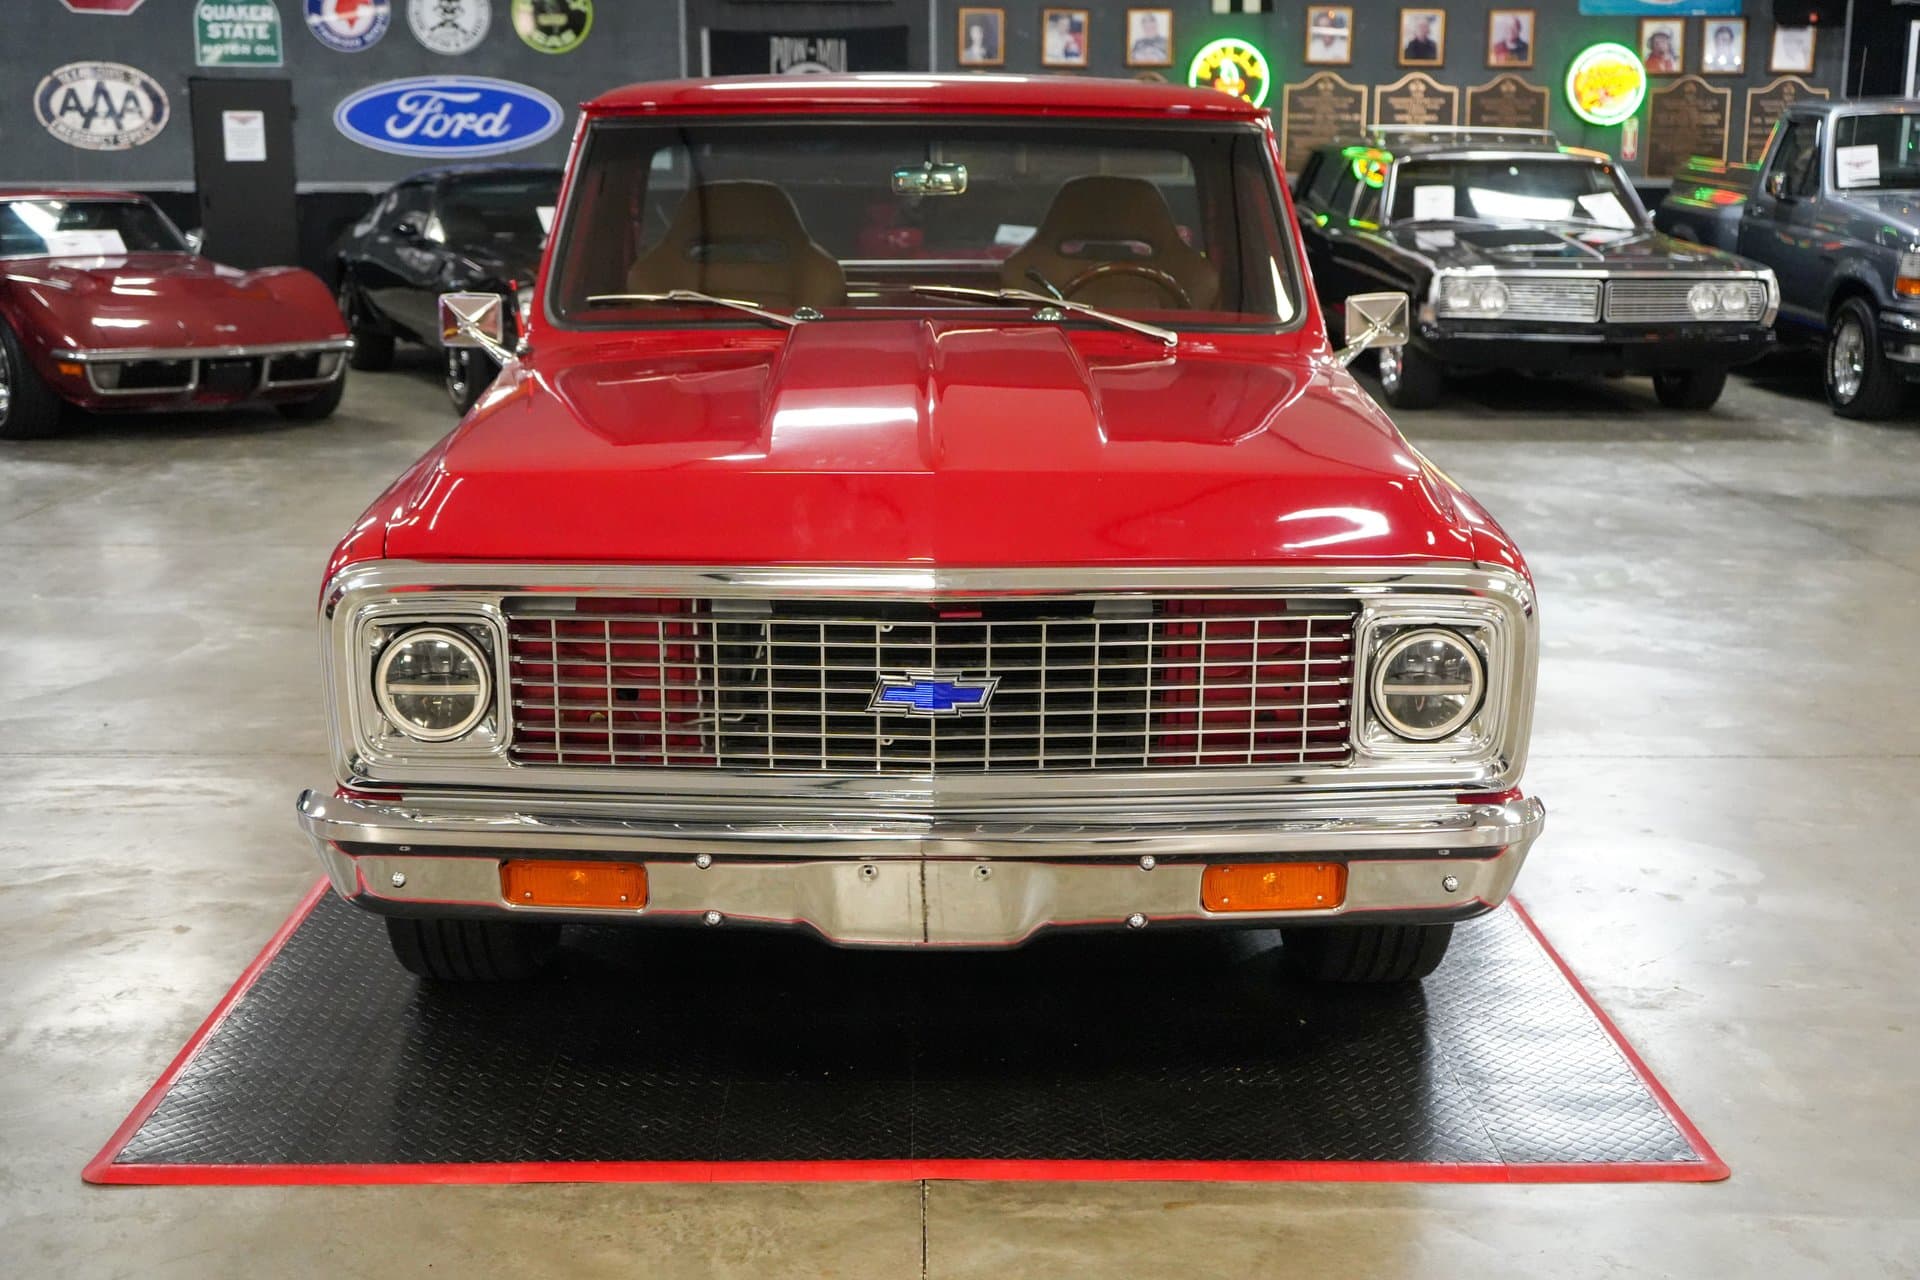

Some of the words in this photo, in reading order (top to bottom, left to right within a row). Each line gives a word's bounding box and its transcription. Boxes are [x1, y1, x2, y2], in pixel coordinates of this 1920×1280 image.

[201, 5, 274, 21] QUAKER
[207, 22, 270, 39] STATE
[59, 81, 144, 130] AAA
[385, 90, 513, 139] Ford
